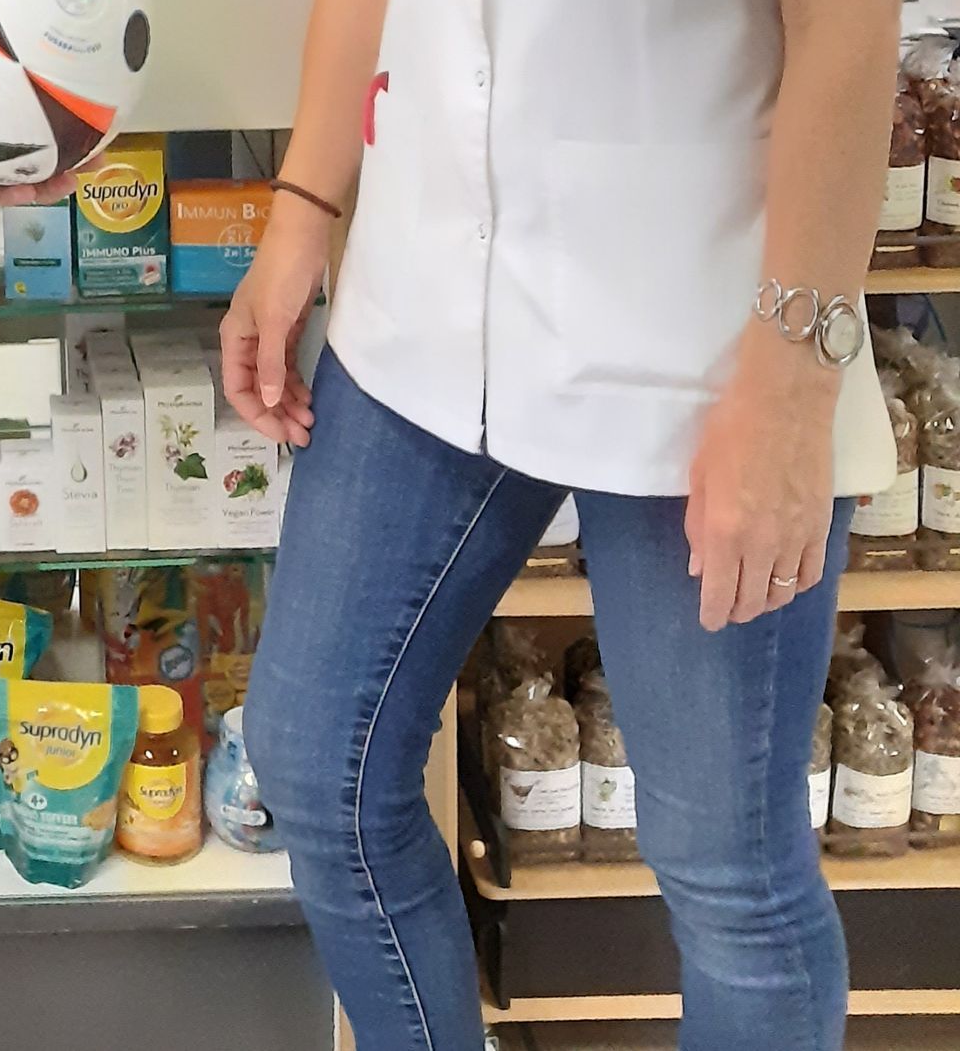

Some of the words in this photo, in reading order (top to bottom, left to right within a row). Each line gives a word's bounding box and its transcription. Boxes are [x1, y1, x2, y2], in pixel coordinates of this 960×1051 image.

[83, 181, 158, 201] Supradyn
[82, 247, 129, 258] IMMUNO
[19, 720, 103, 749] Supradyn
